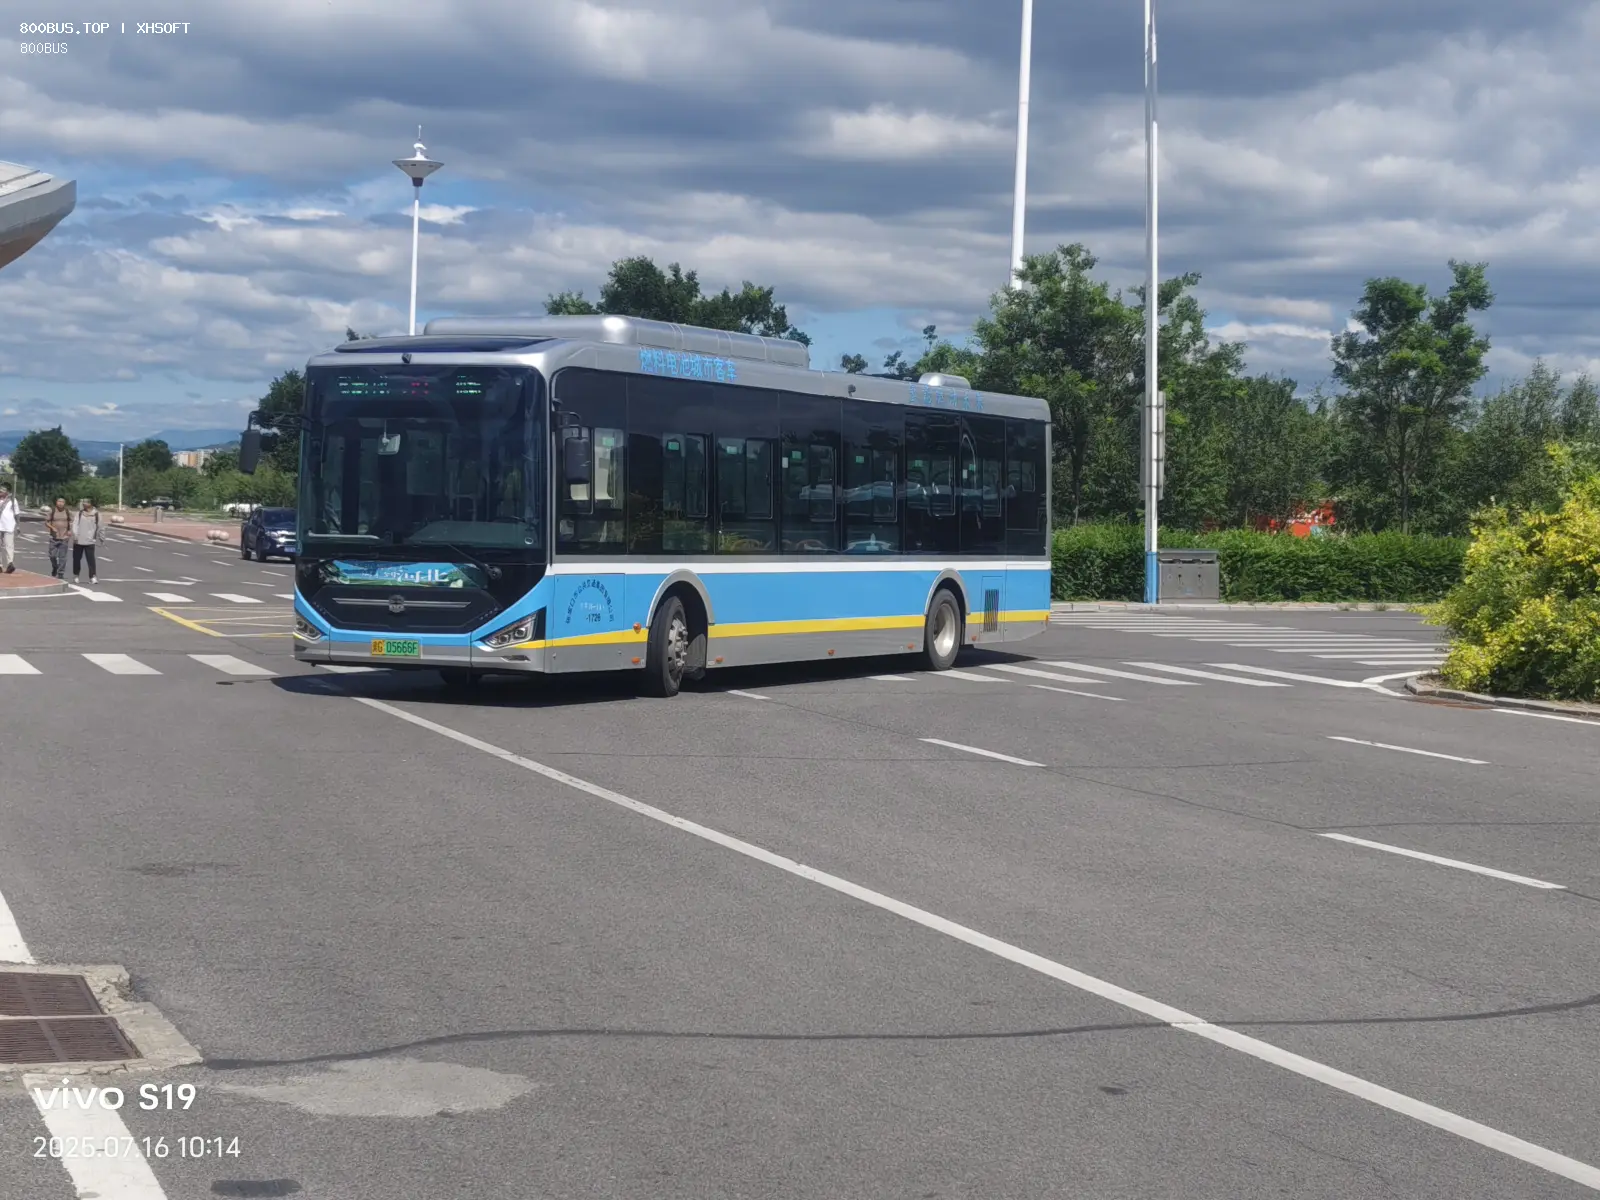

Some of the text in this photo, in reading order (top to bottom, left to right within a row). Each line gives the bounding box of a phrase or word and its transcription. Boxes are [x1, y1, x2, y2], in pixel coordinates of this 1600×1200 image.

[639, 347, 738, 382] 燃料电池城市客车
